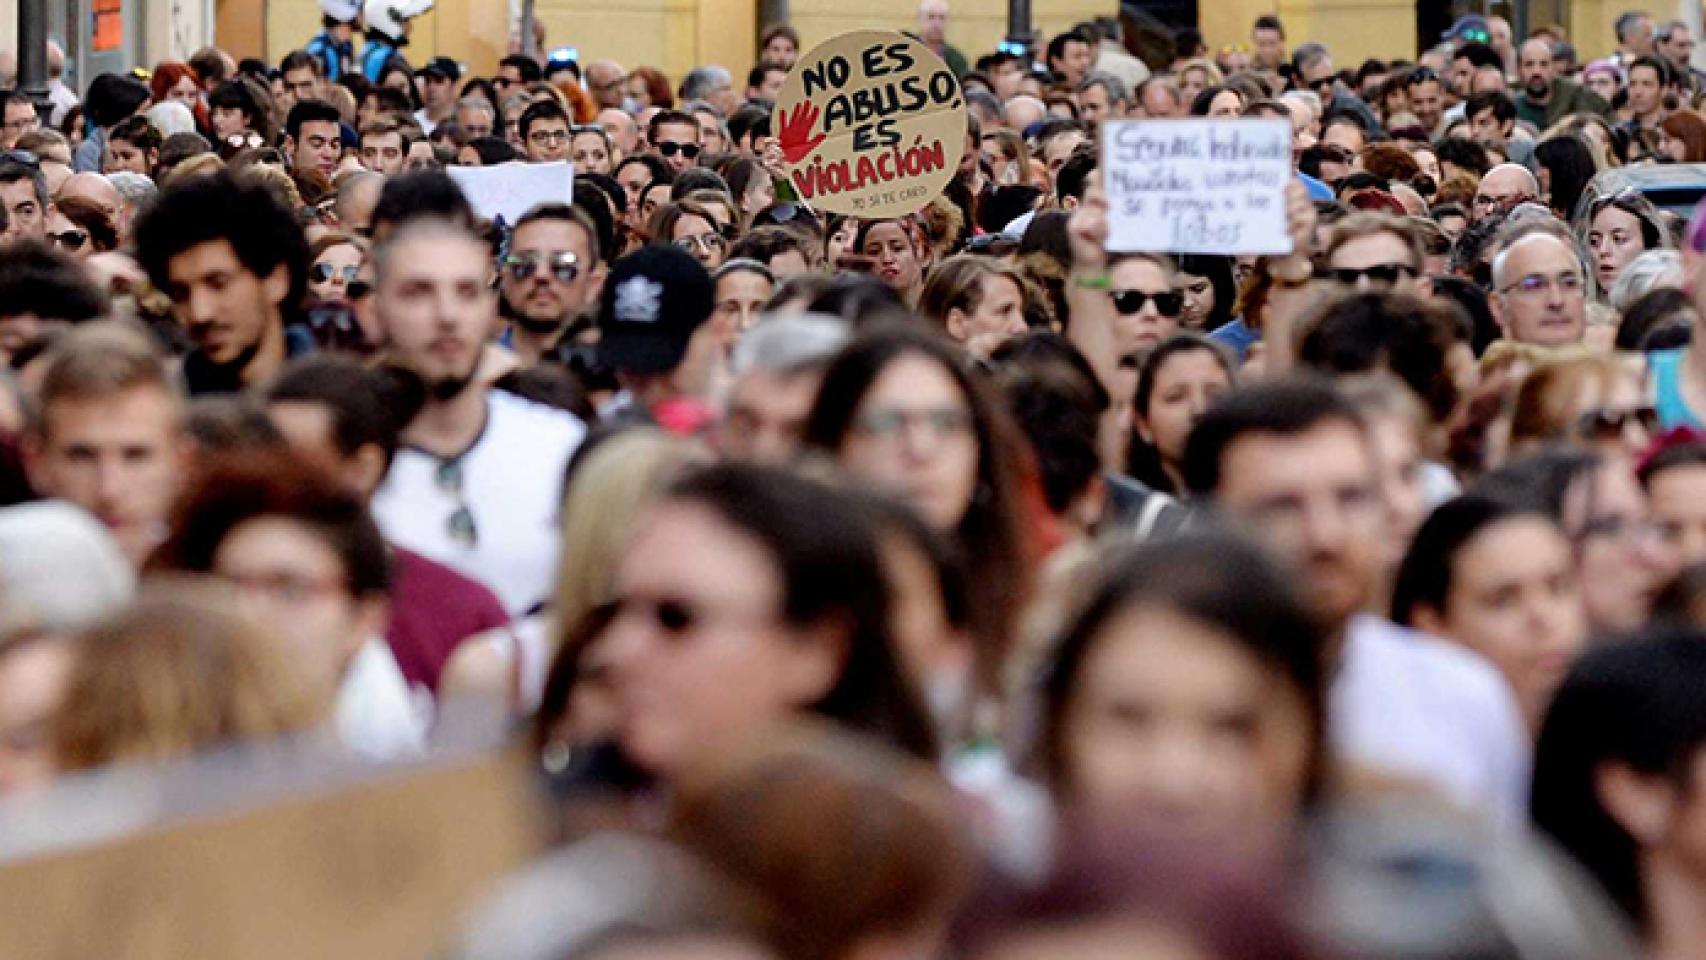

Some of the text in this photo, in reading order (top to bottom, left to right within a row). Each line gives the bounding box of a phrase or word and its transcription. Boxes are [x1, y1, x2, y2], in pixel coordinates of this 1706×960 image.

[802, 44, 914, 96] NO ES
[824, 71, 961, 132] ABUSO,
[853, 120, 902, 152] ES
